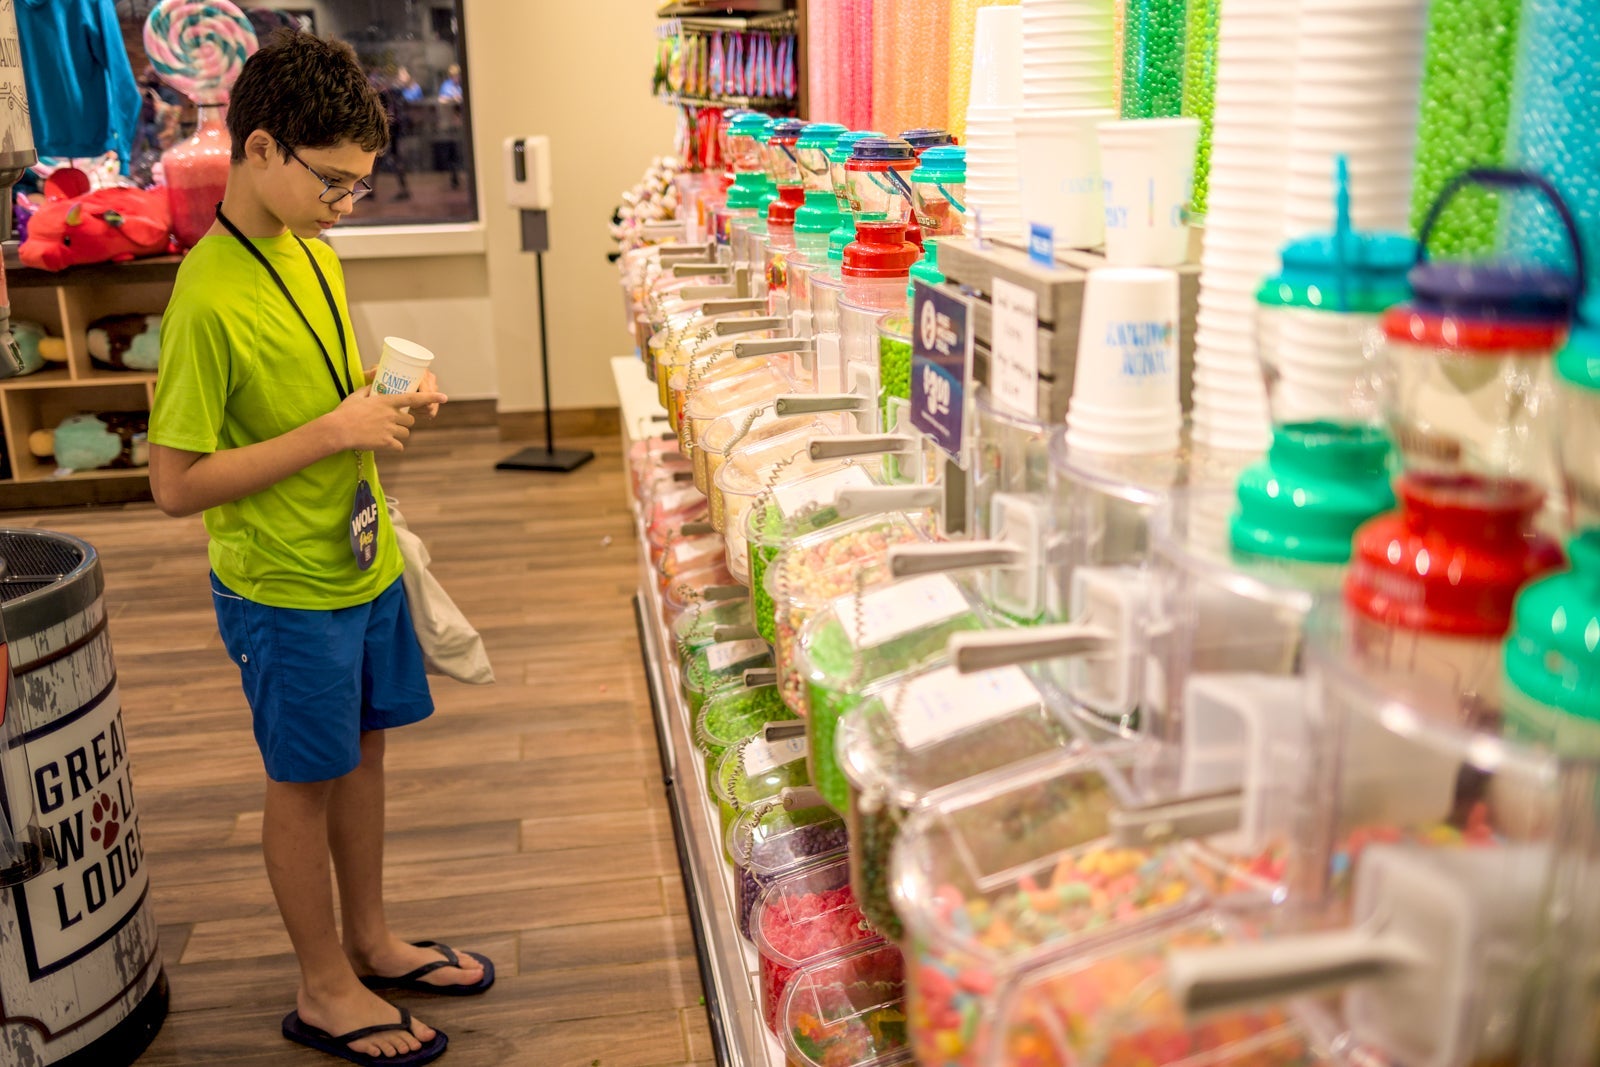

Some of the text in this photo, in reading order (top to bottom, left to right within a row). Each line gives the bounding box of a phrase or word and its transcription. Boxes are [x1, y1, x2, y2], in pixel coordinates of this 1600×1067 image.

[382, 371, 411, 391] CANDY
[352, 503, 377, 537] WOLF
[34, 706, 127, 815] GREAT
[53, 816, 144, 931] LODGE
